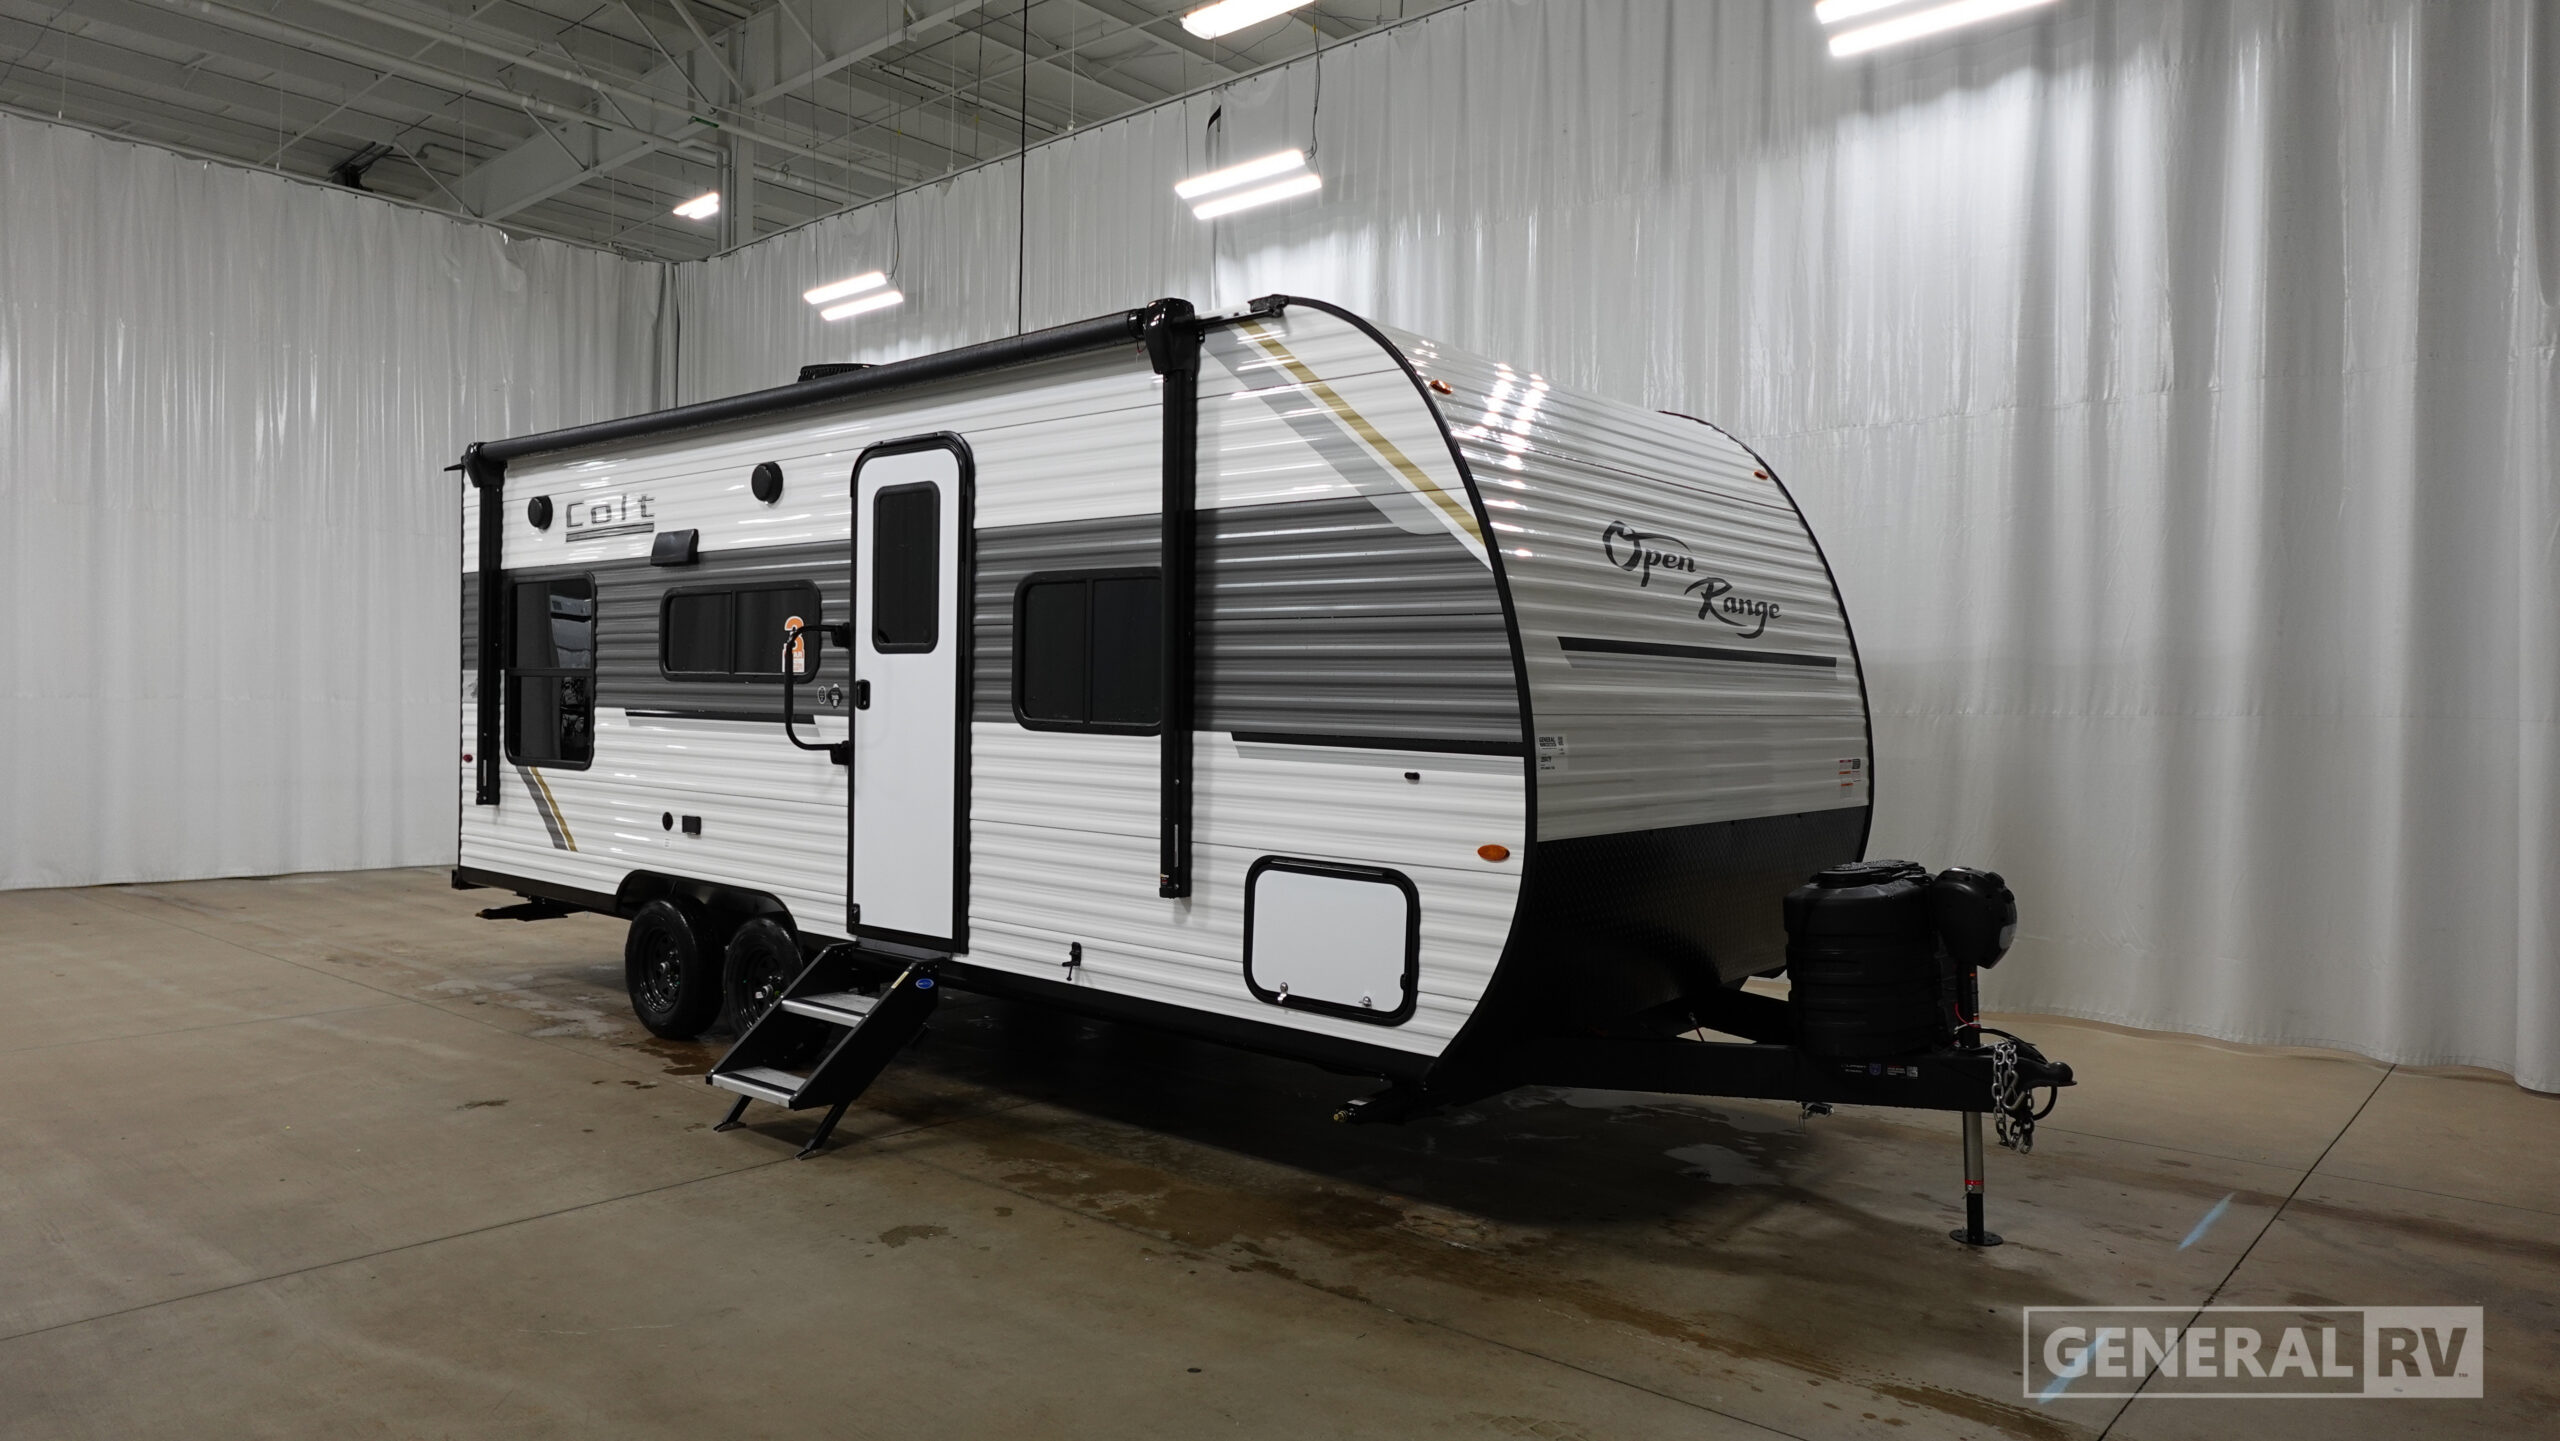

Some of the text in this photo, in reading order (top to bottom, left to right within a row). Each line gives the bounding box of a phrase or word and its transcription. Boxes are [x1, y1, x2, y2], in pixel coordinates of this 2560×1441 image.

[566, 495, 655, 528] Colt
[1602, 520, 1696, 587] Open
[1684, 577, 1782, 639] Range
